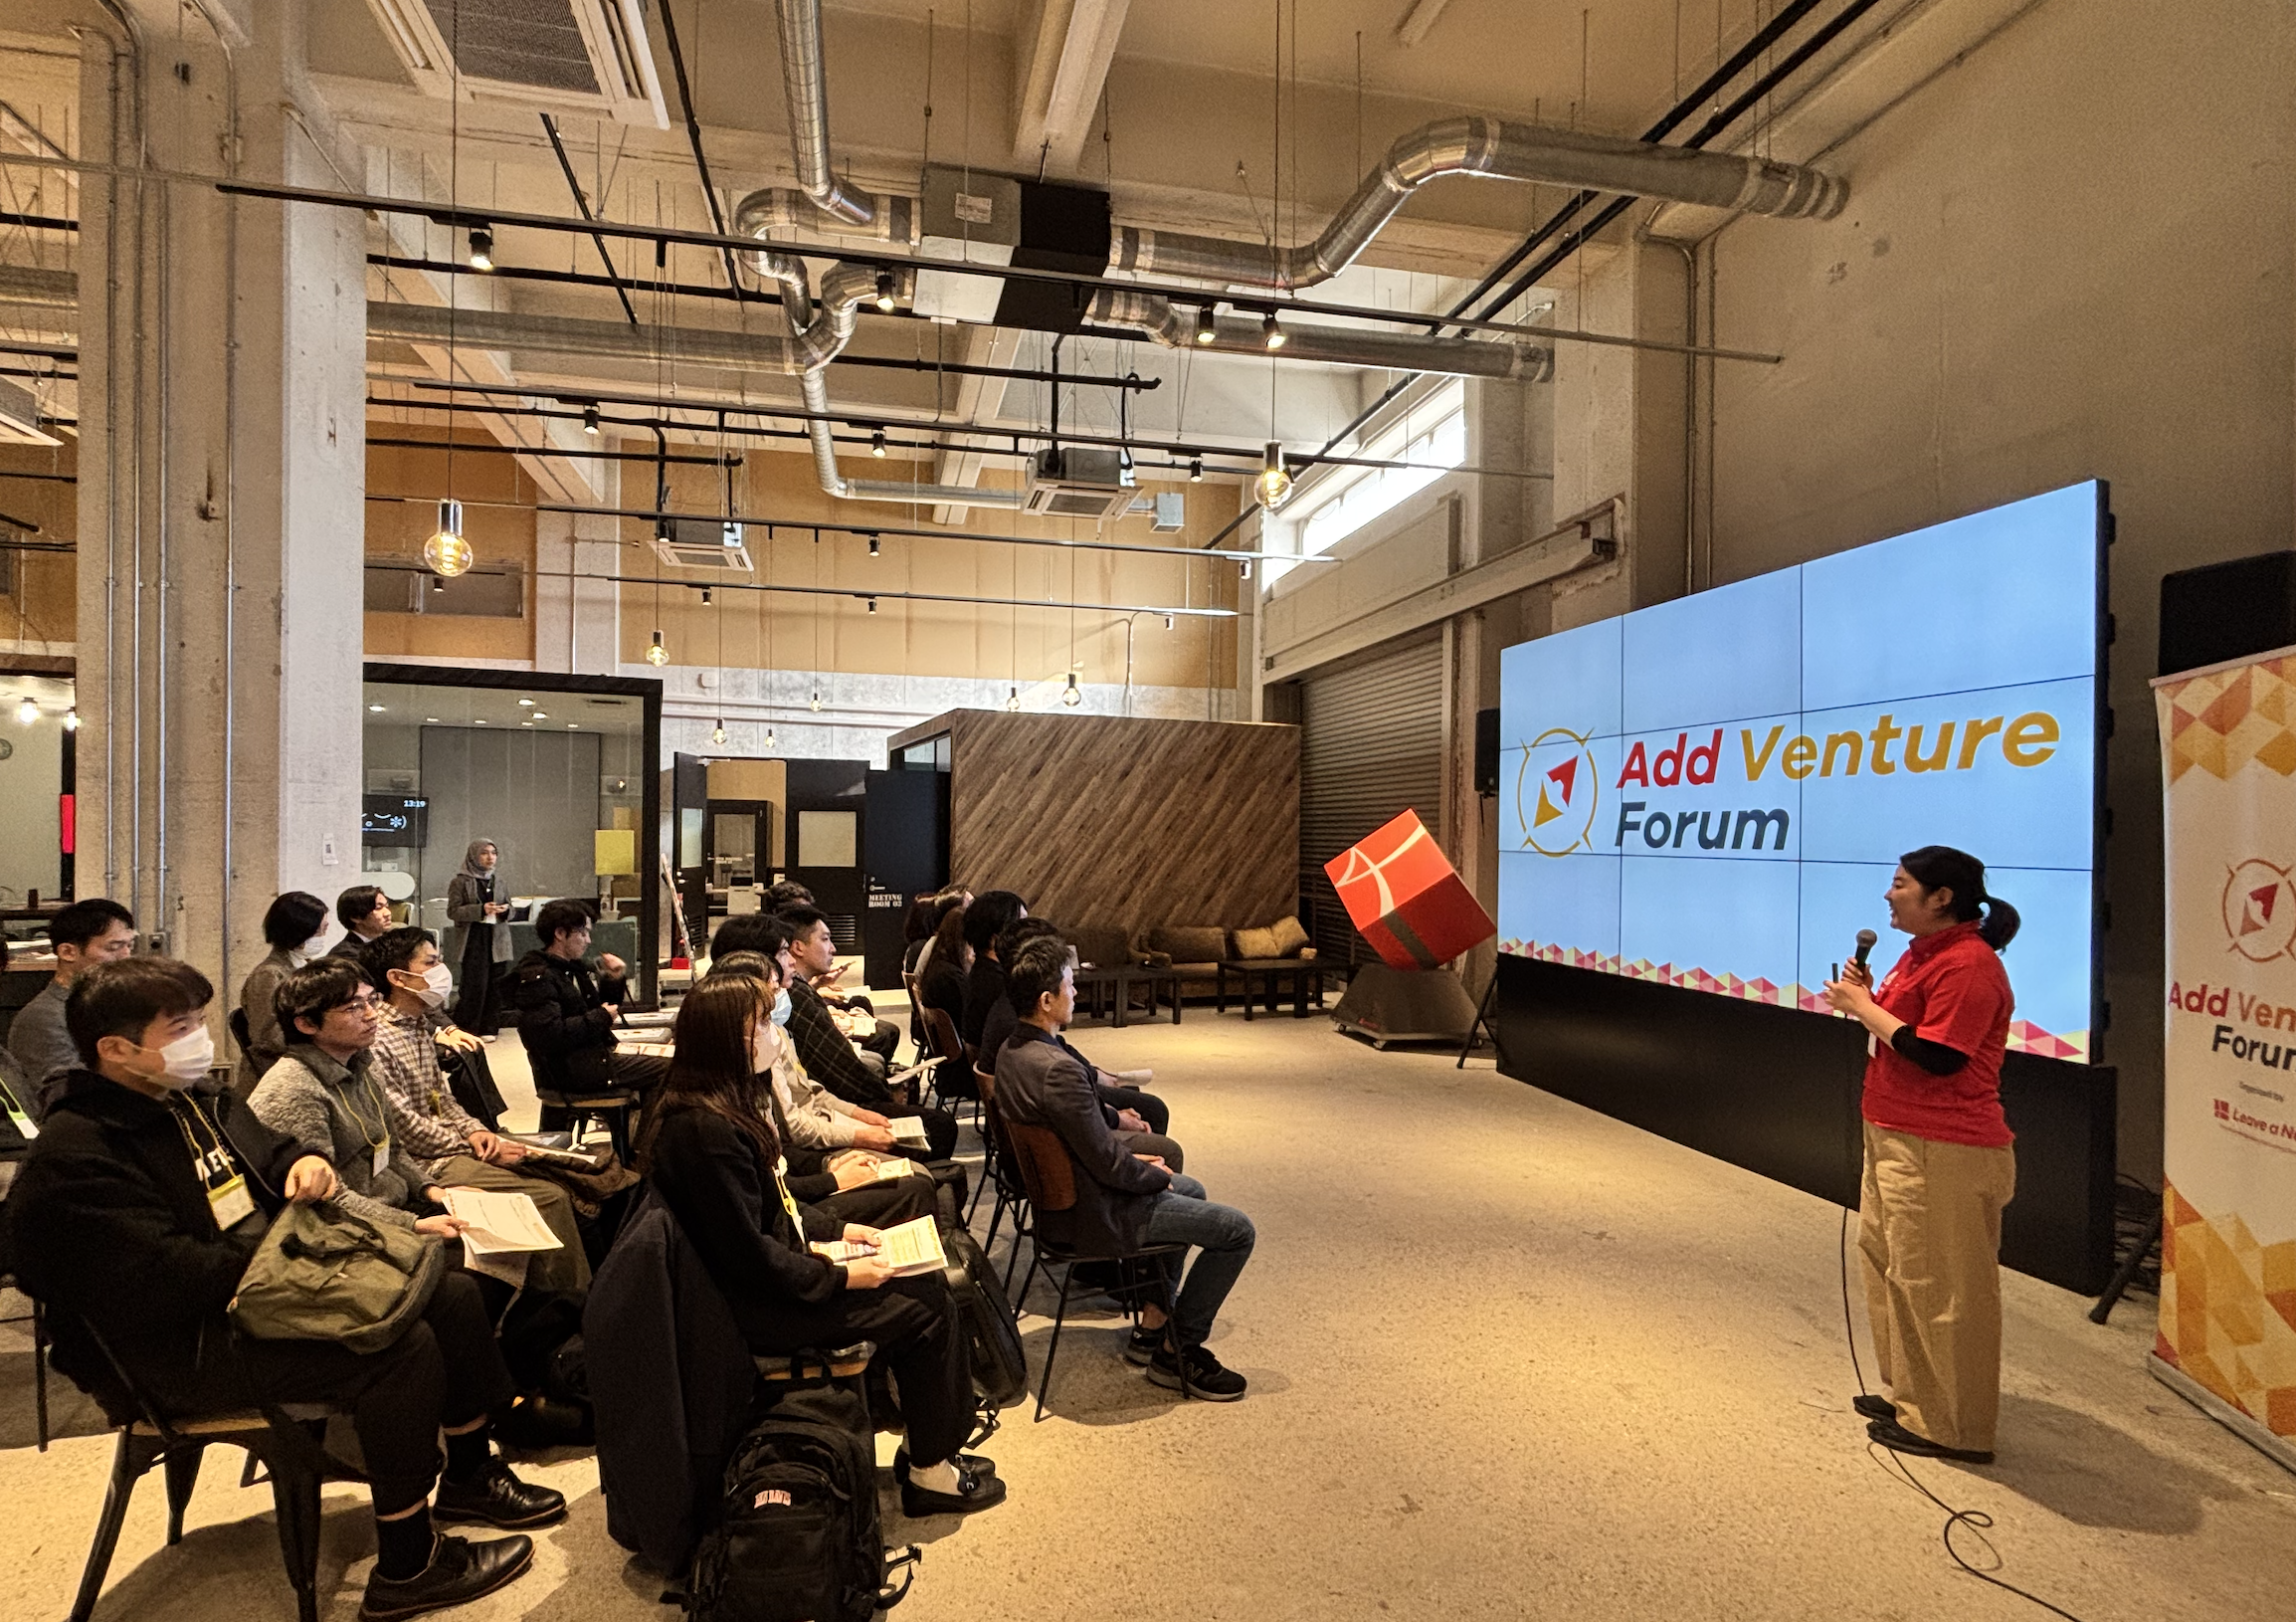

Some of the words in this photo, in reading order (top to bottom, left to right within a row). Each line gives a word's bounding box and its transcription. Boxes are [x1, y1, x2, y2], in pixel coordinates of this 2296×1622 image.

[1615, 728, 1723, 789] Add
[1741, 710, 2061, 782] Venture
[1614, 801, 1790, 851] Forum
[2169, 980, 2230, 1018] Add
[2232, 1108, 2267, 1131] Leave
[2269, 1123, 2279, 1135] a
